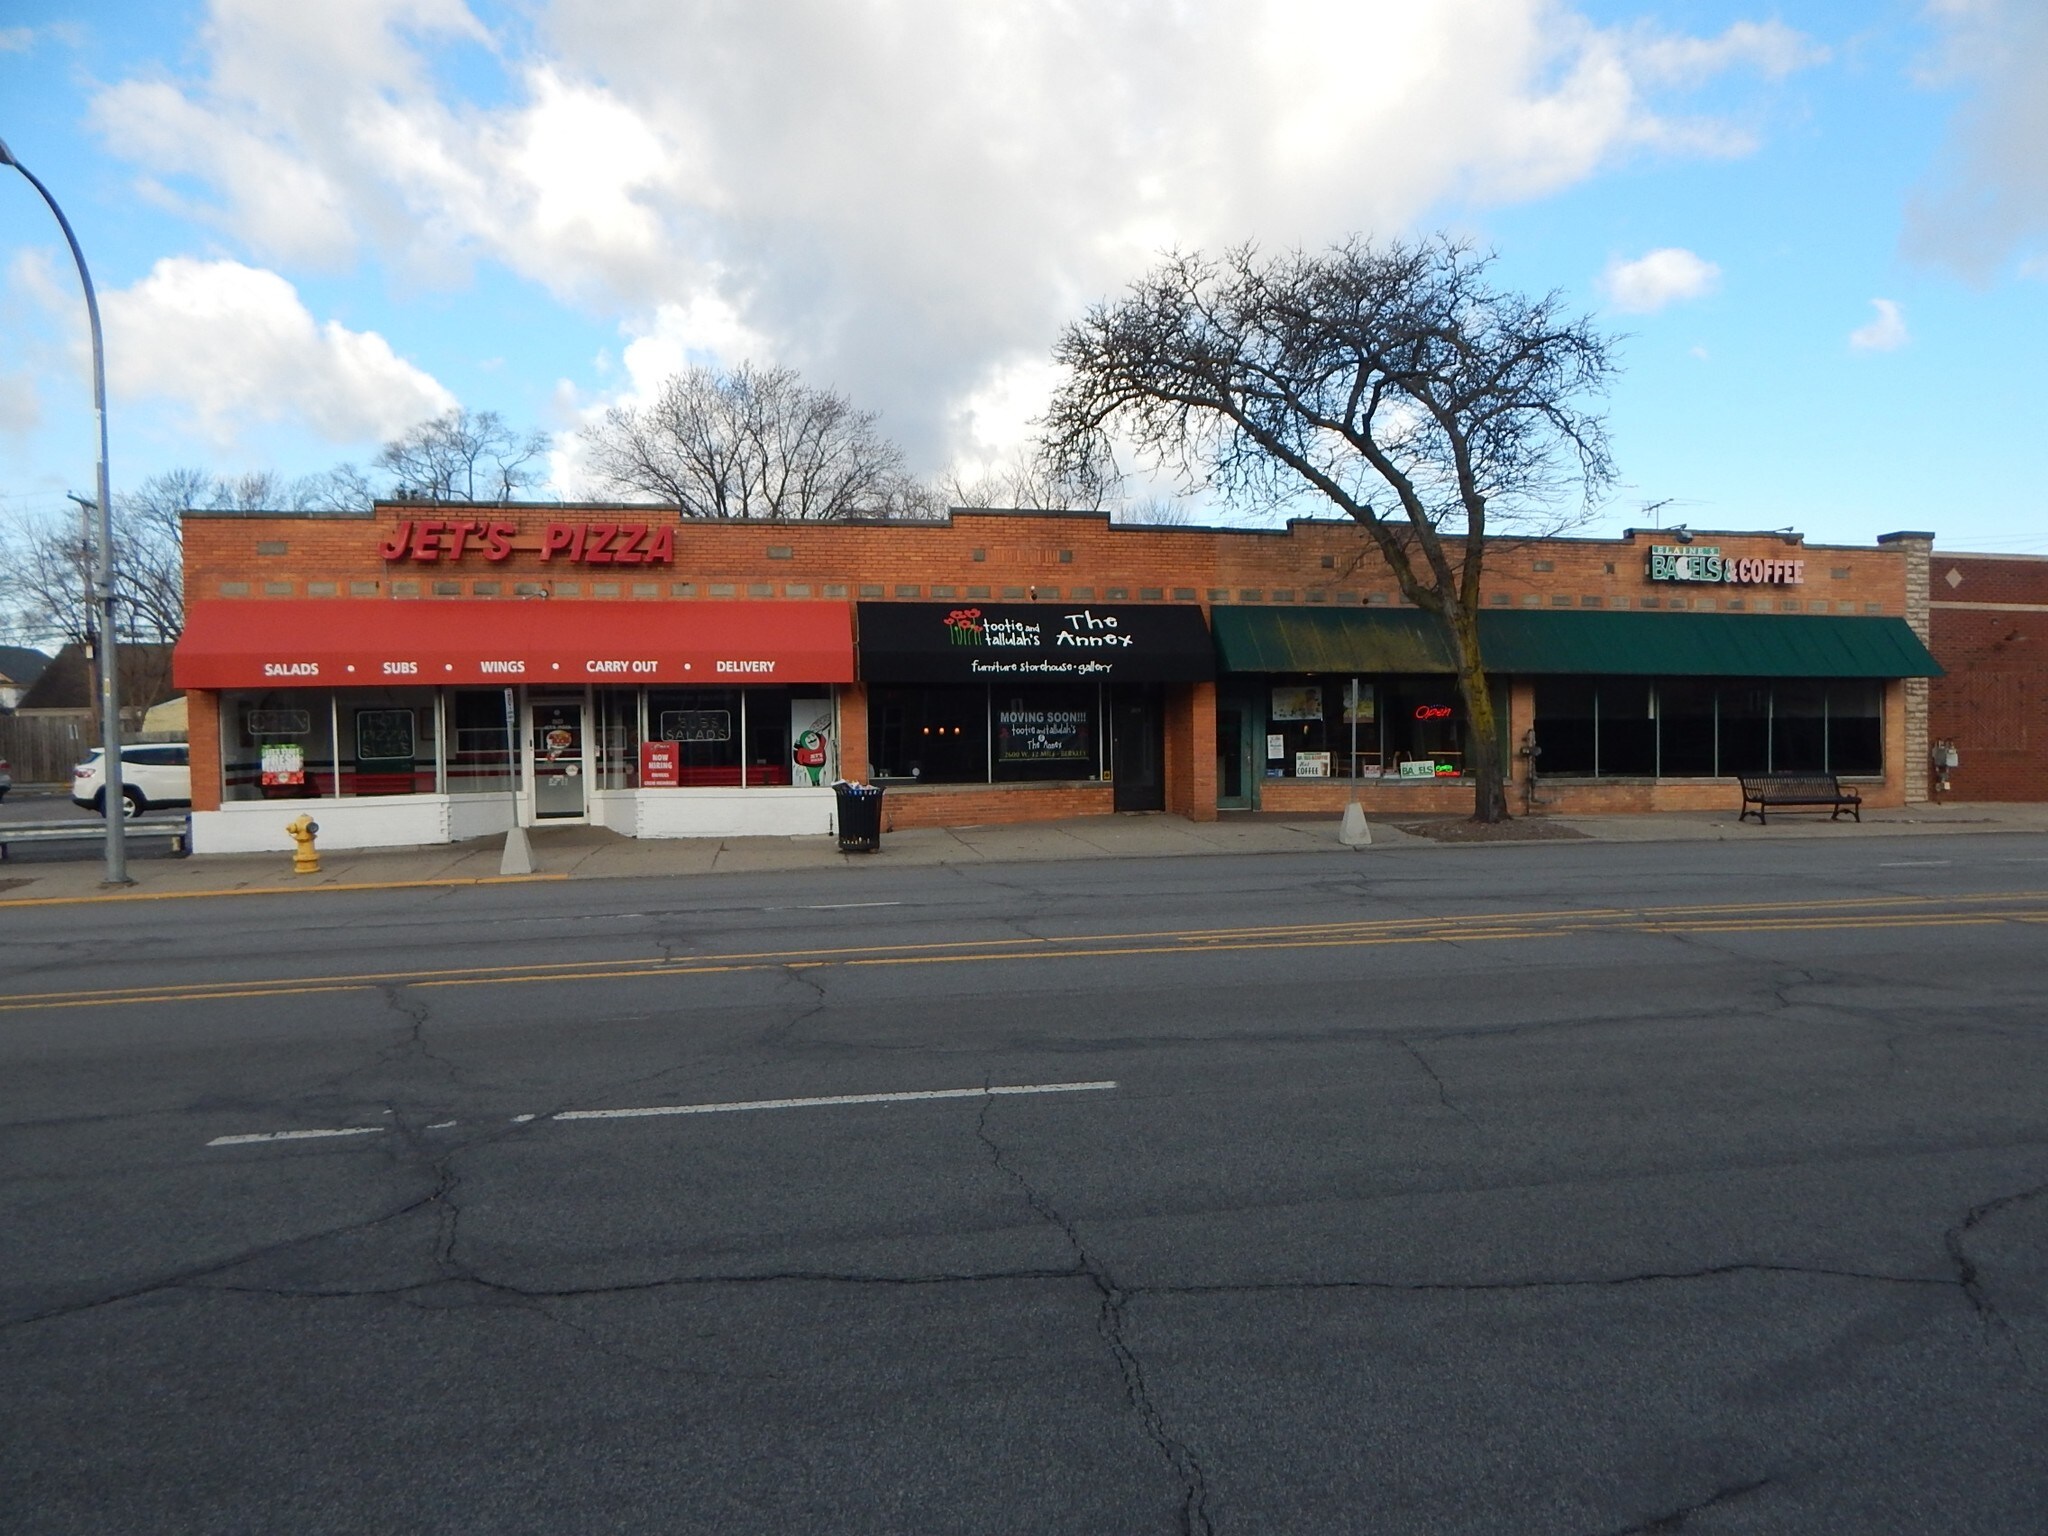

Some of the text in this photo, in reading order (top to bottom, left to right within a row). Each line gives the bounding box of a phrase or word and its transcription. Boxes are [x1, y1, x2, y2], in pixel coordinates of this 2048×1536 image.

[379, 521, 675, 563] JET'S PIZZA
[1739, 558, 1804, 584] COFFEE
[983, 618, 1040, 633] tootie and
[1064, 610, 1118, 630] The
[985, 632, 1040, 646] tallulah's
[1056, 630, 1133, 647] Annex
[264, 660, 775, 676] SALADS SUBS WINGS CARRY OUT DELIVERY
[971, 659, 1113, 675] furniture storehouse gallery
[1000, 712, 1086, 722] MOVING SOON!!!
[1415, 705, 1452, 719] Open
[666, 729, 727, 740] SALADS
[1297, 767, 1318, 775] COFFEE
